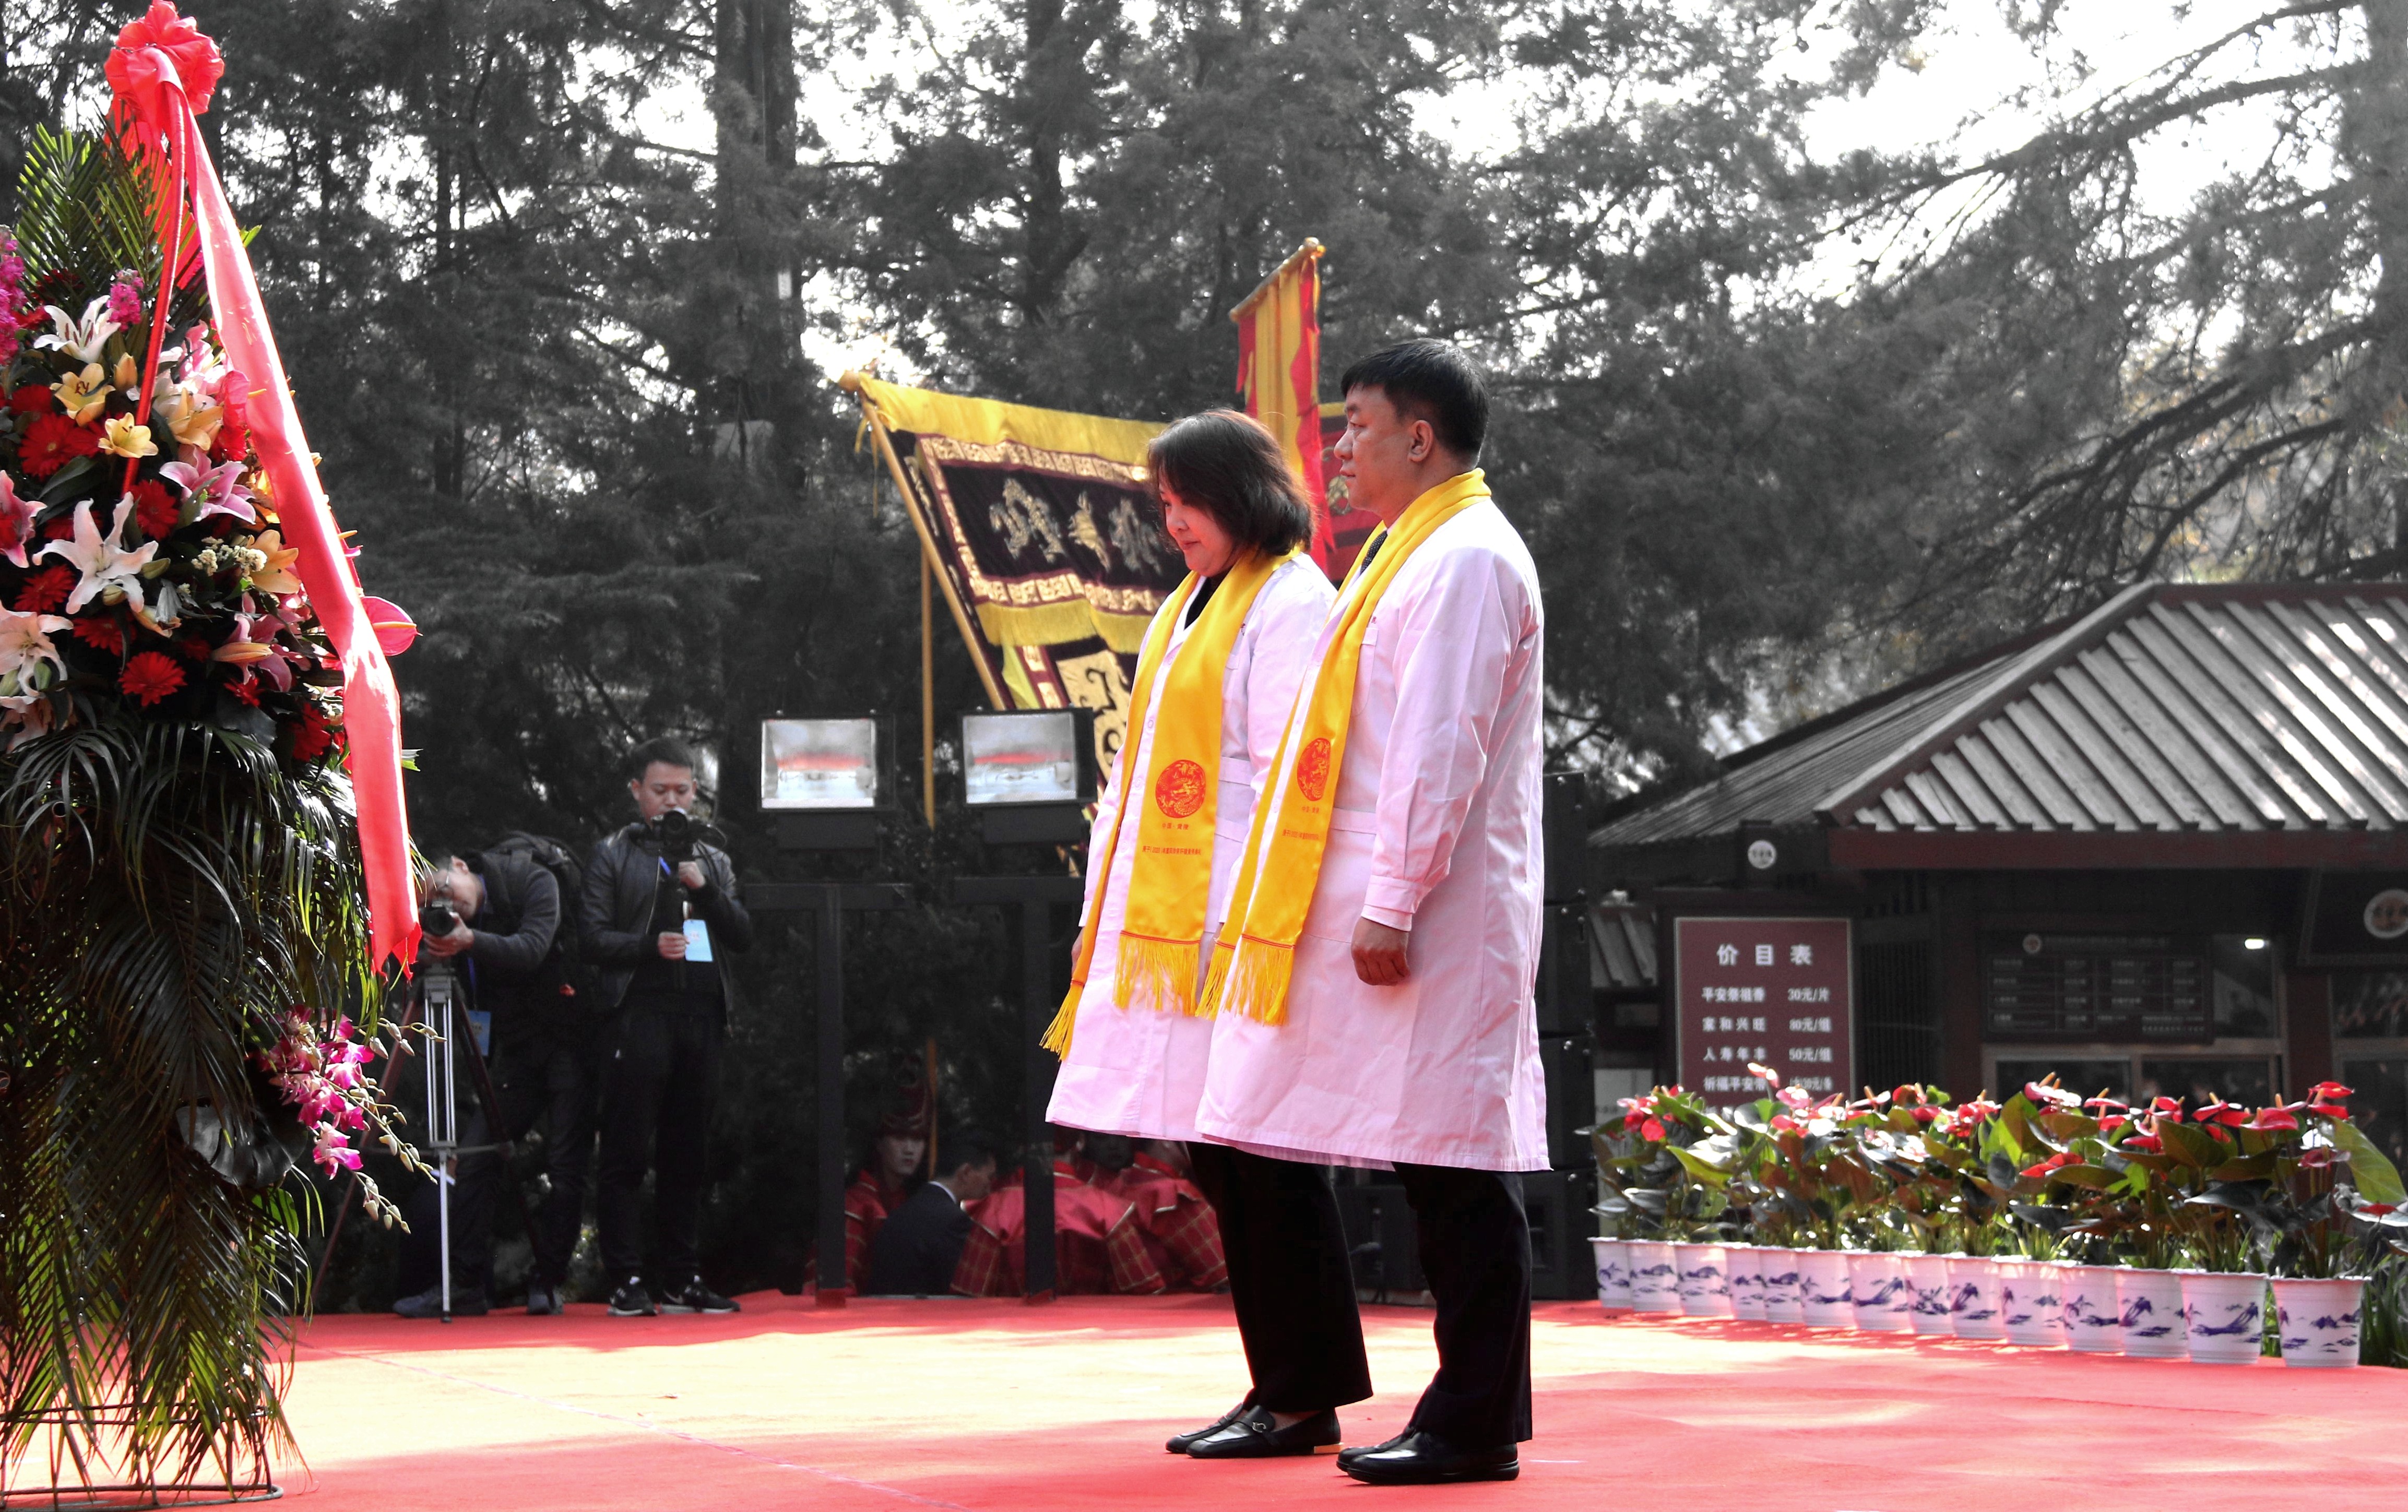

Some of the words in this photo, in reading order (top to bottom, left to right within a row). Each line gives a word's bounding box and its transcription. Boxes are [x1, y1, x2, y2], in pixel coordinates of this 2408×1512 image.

[1716, 943, 1812, 966] 价目表
[1702, 1016, 1766, 1032] 家和兴旺
[1703, 1046, 1766, 1062] 人寿年丰
[1788, 1046, 1833, 1063] 50元/组
